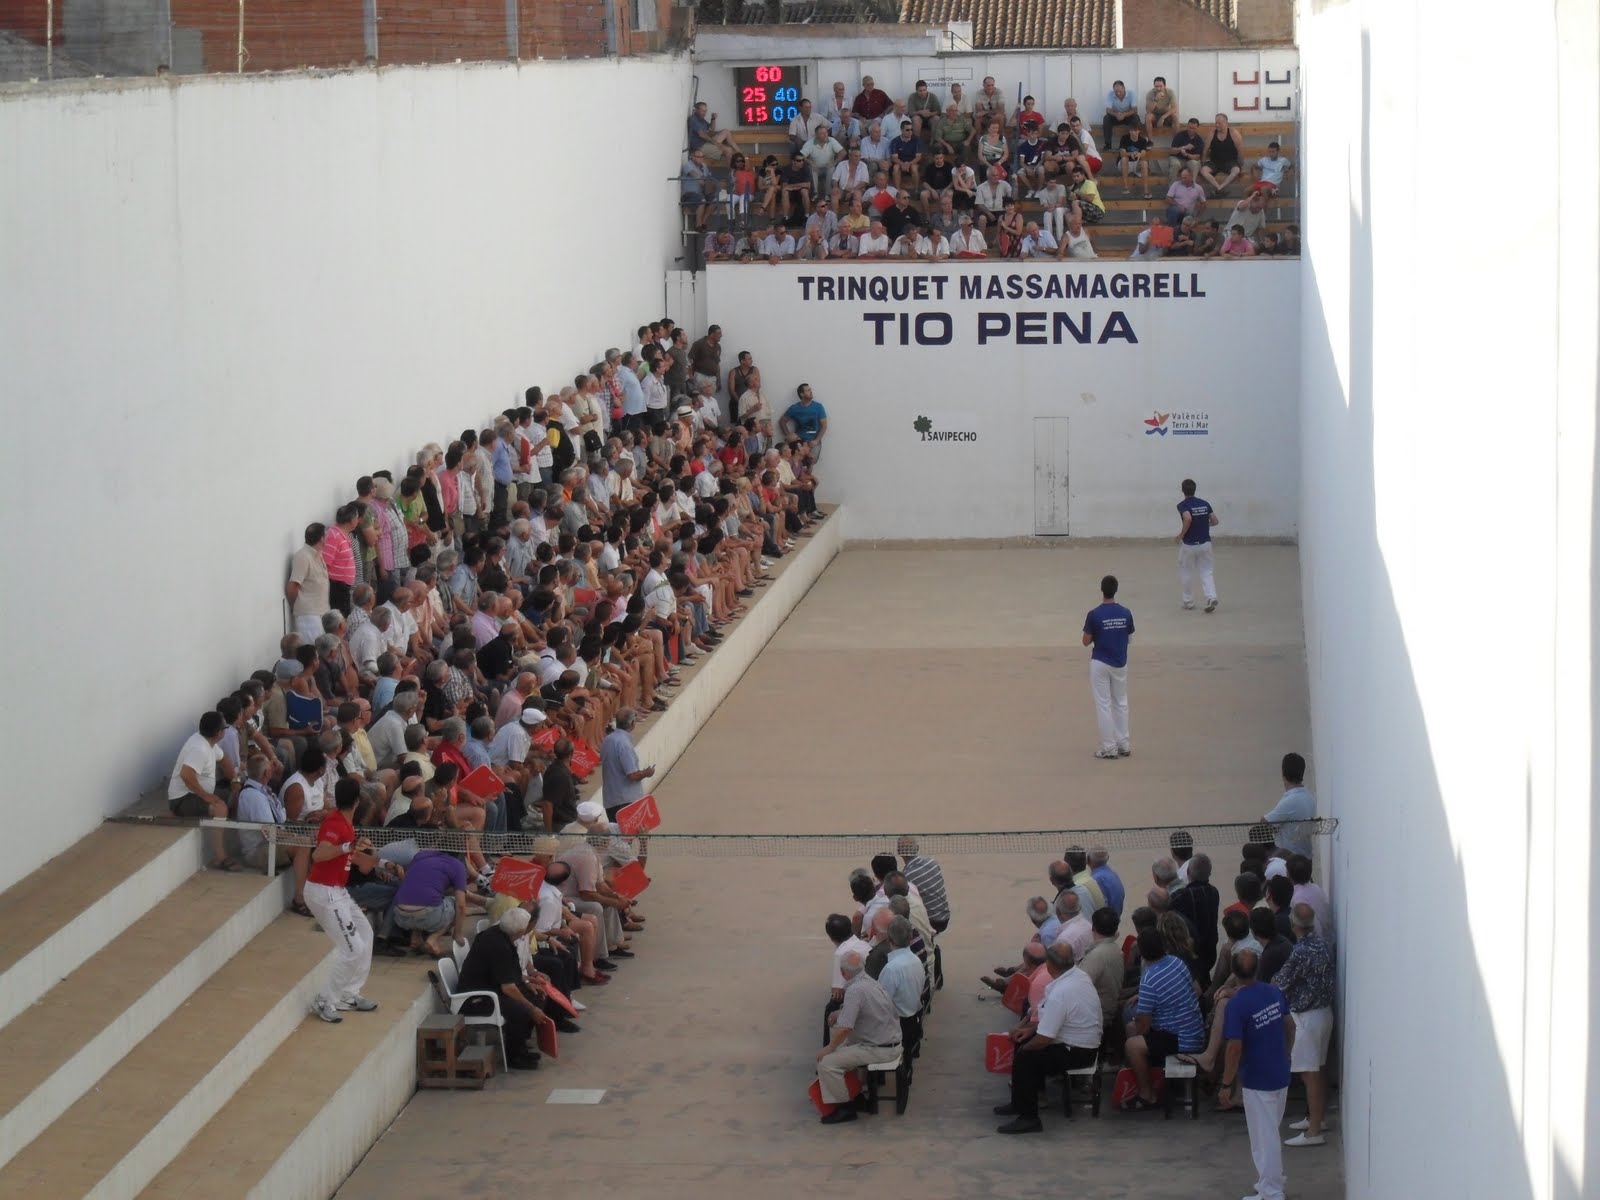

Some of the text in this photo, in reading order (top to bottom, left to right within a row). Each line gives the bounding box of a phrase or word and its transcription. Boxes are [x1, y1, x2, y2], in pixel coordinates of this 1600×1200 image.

[756, 66, 782, 82] 60
[743, 87, 798, 102] 25 40
[745, 106, 798, 122] 15 00
[797, 273, 1206, 303] TRINQUET MASSAMAGRELL
[863, 311, 1139, 346] TIO PENA
[1171, 412, 1209, 420] València
[1171, 421, 1189, 429] Terra
[1196, 421, 1209, 429] Mar
[927, 431, 977, 442] SAVIPECHO
